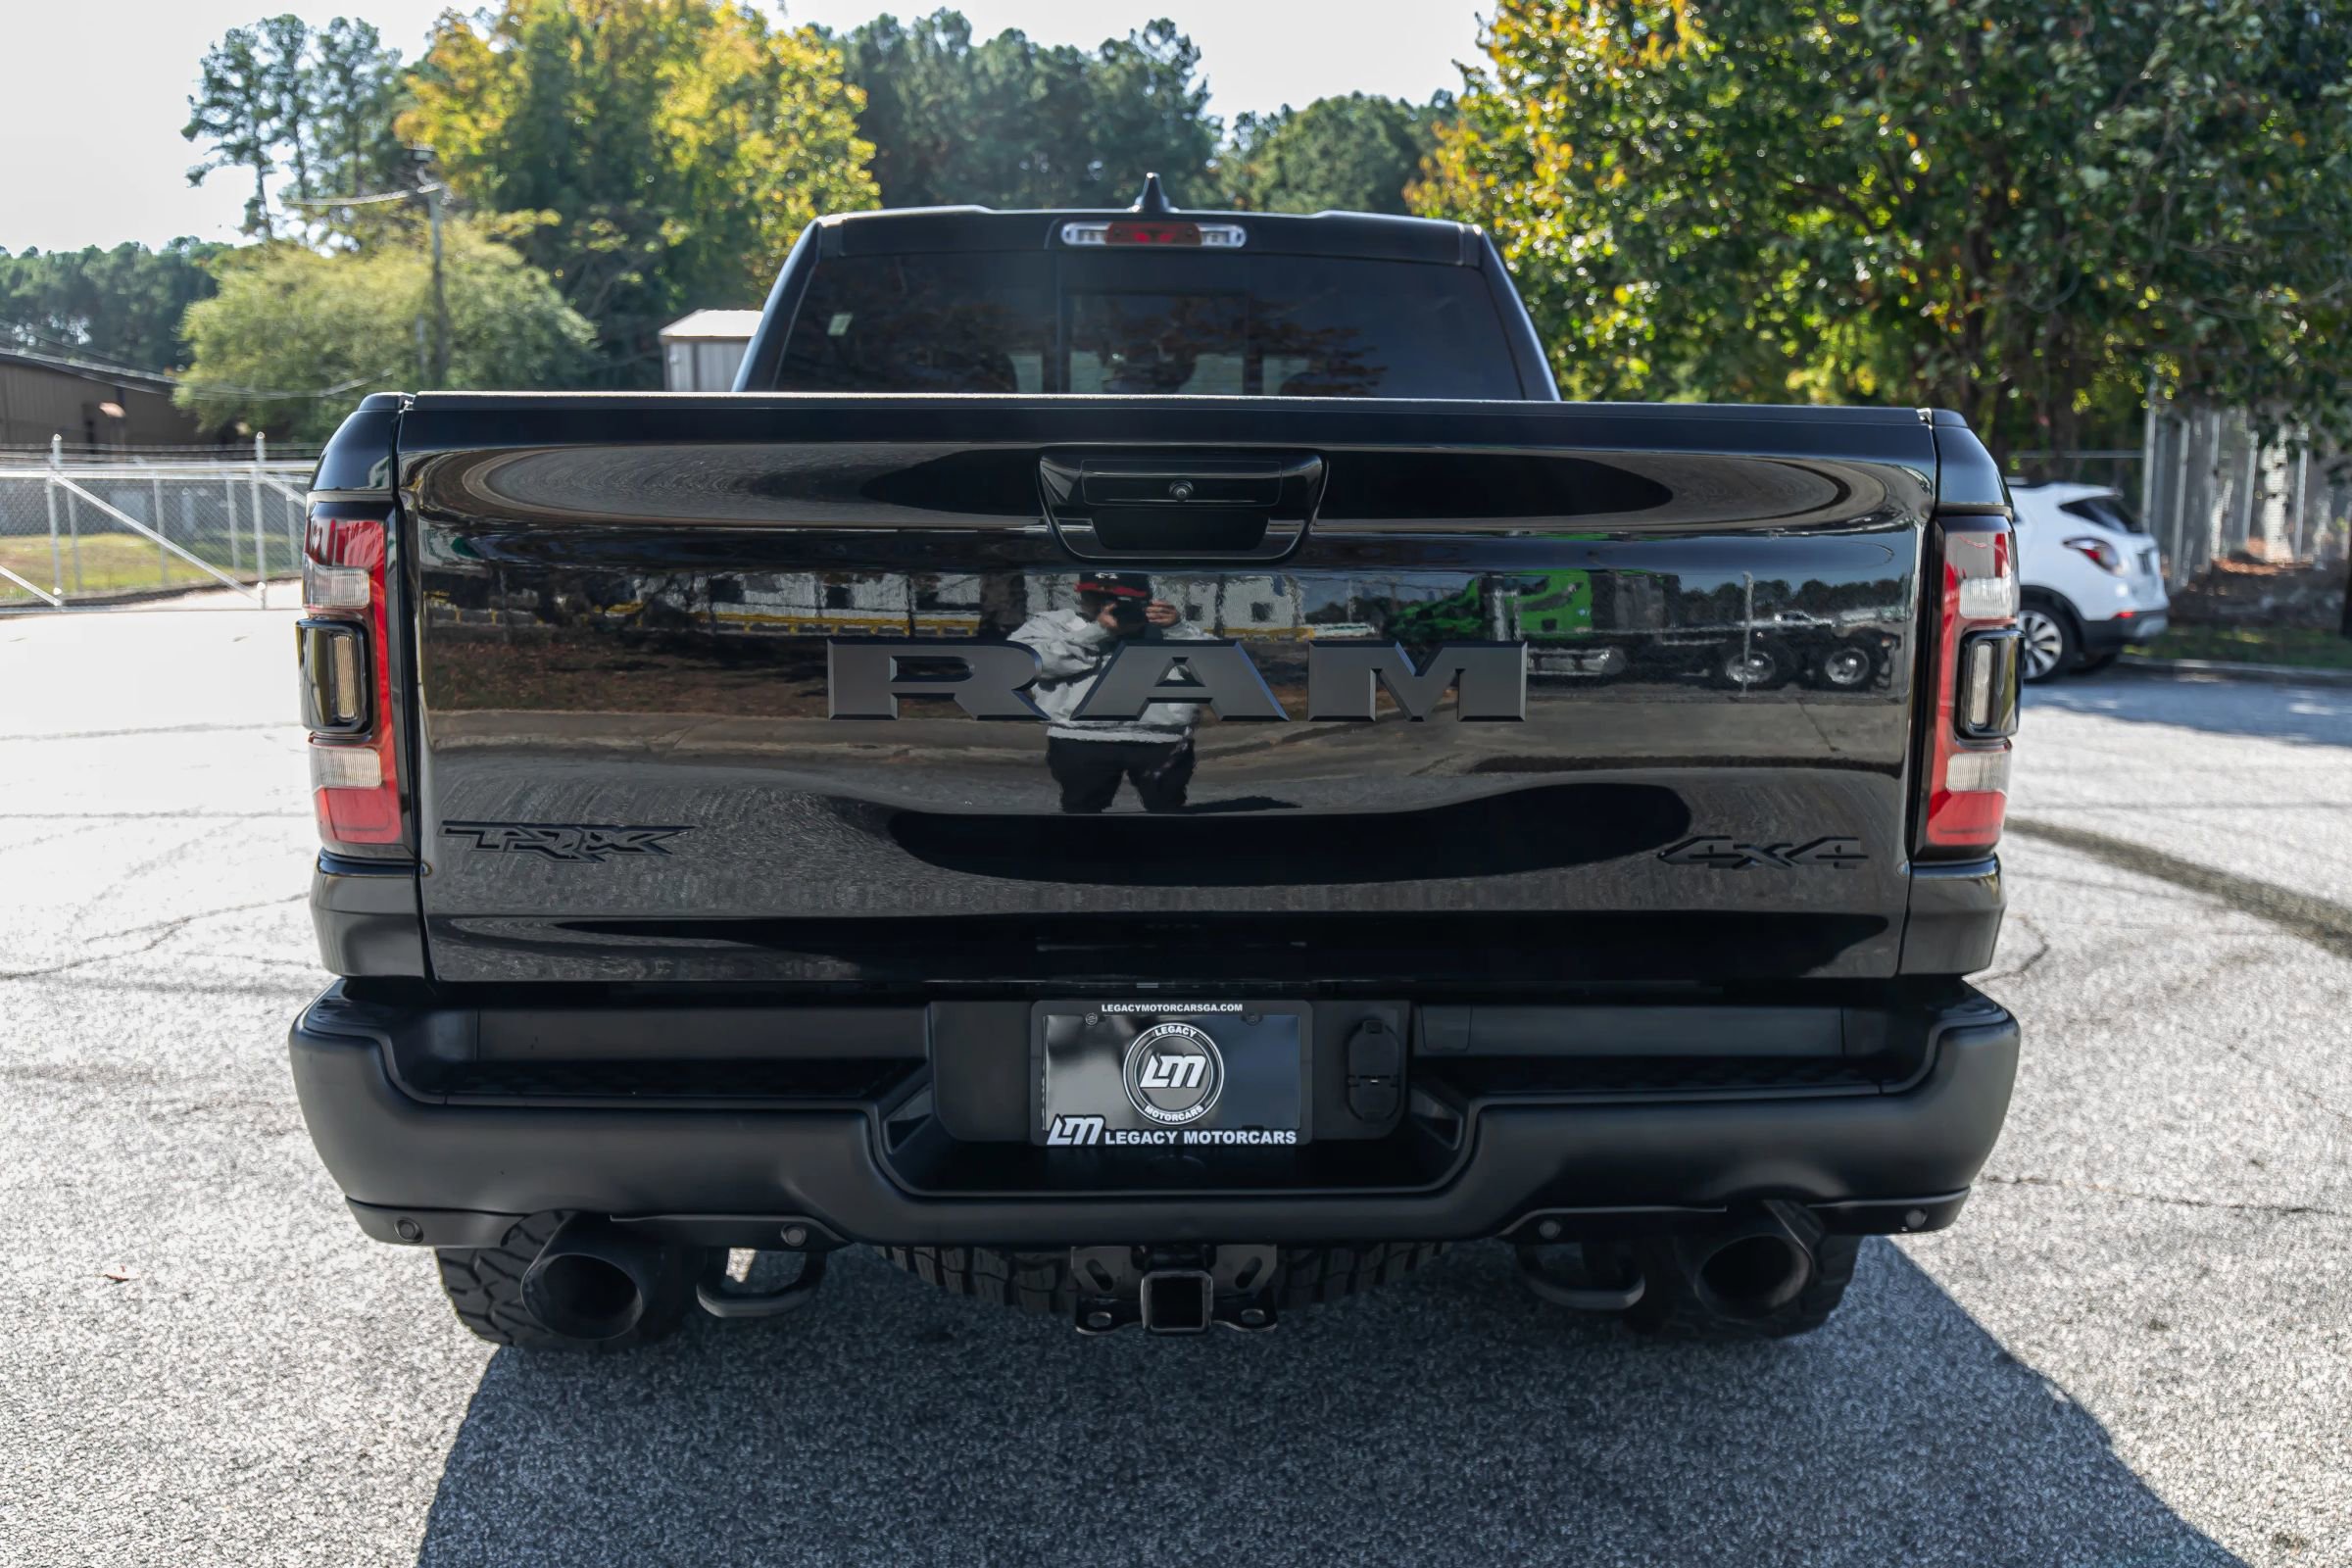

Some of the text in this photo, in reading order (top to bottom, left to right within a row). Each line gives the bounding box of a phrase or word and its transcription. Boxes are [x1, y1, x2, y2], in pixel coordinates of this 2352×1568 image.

[828, 639, 1528, 721] RAM
[439, 820, 696, 862] TRX
[1102, 1004, 1243, 1012] LEGACYMOTORCARSGA.COM
[1154, 1025, 1198, 1038] LEGACY
[1144, 1104, 1204, 1122] MOTORCARS
[1105, 1131, 1178, 1145] LEGACY
[1183, 1131, 1298, 1145] MOTORCARS
